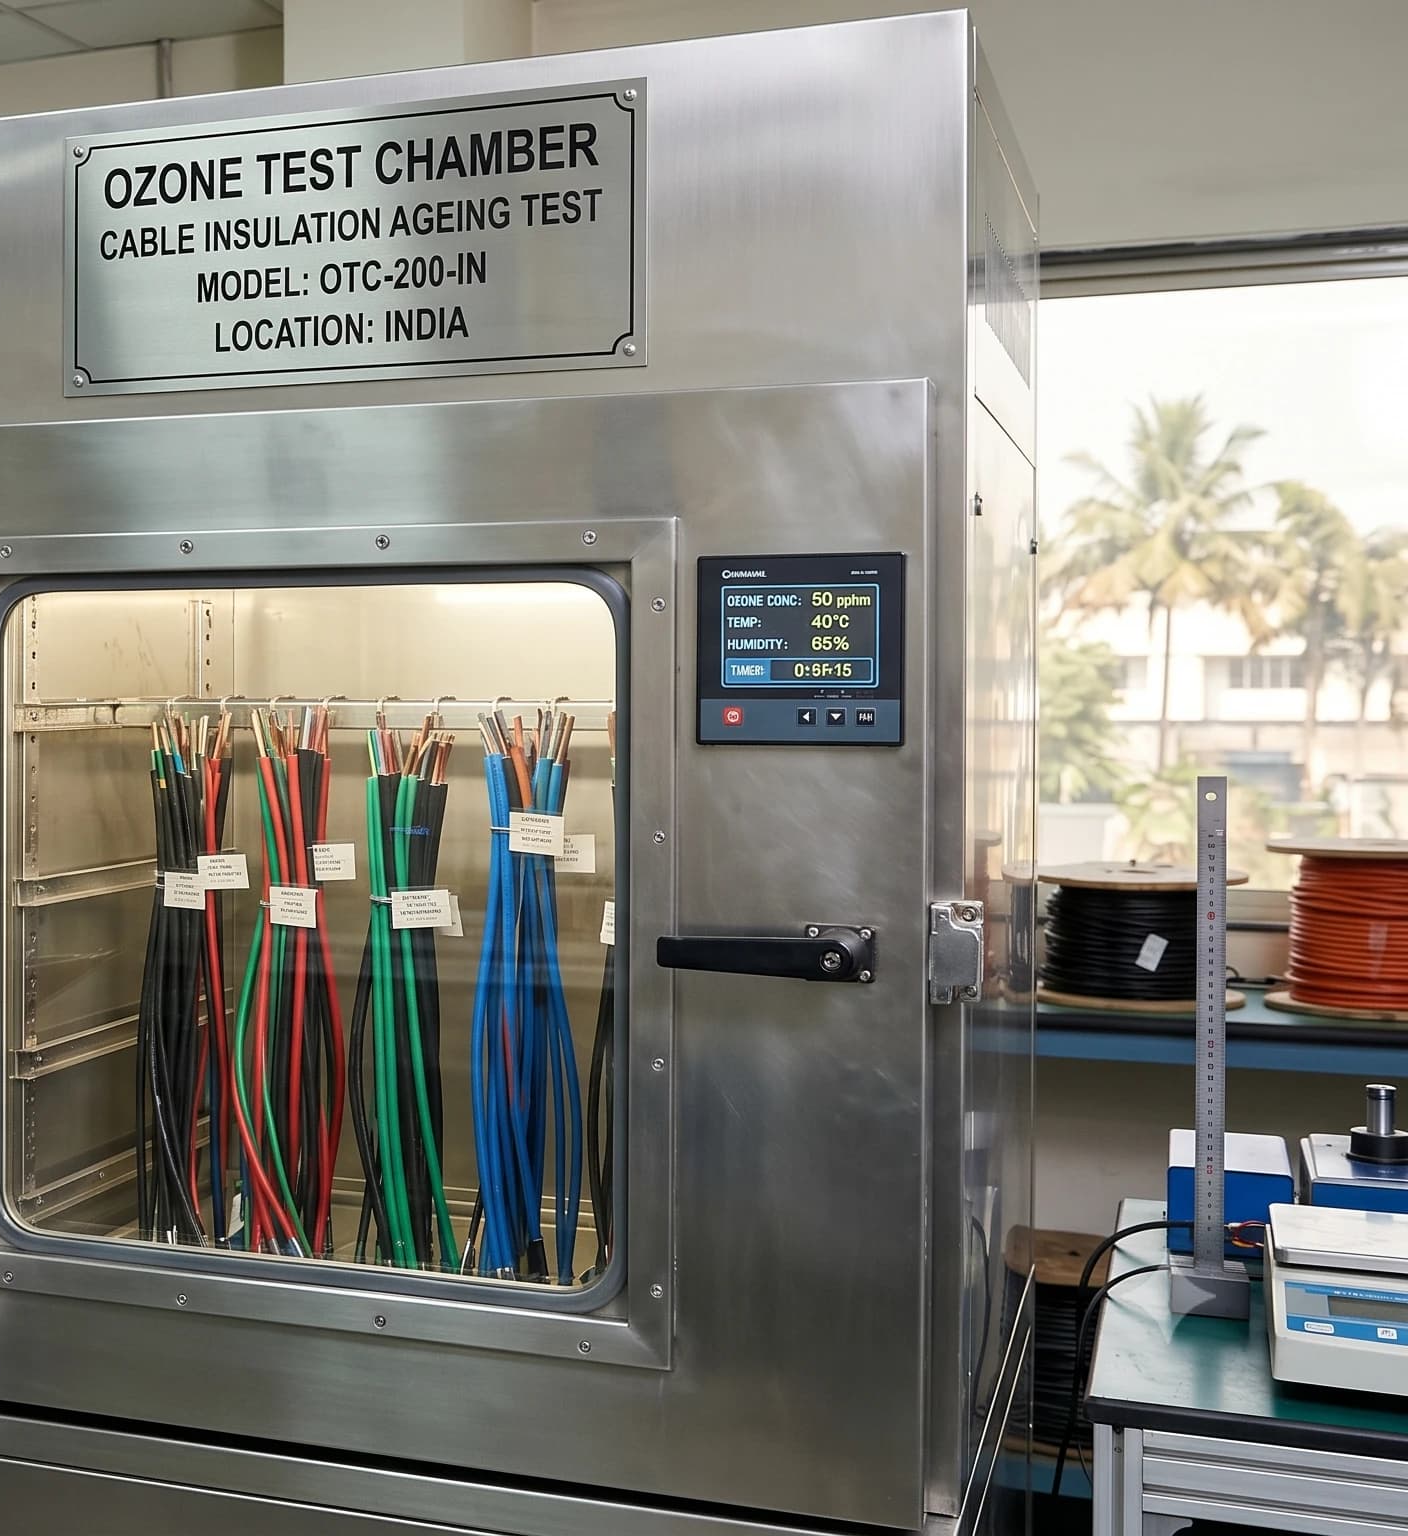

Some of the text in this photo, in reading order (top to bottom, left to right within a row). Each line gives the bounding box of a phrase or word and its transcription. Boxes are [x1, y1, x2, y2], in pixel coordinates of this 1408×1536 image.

[104, 122, 599, 209] OZONE TEST CHAMBER
[100, 189, 603, 261] CABLE INSULATION AGEING TEST
[197, 251, 486, 303] MODEL: OTC-200-IN
[215, 307, 469, 353] LOCATION: INDIA
[727, 614, 850, 629] TEMP: 40°C
[767, 594, 802, 607] CONC:
[811, 591, 833, 607] 50
[836, 593, 872, 609] pphm
[727, 636, 850, 651] HUMIDITY: 65%
